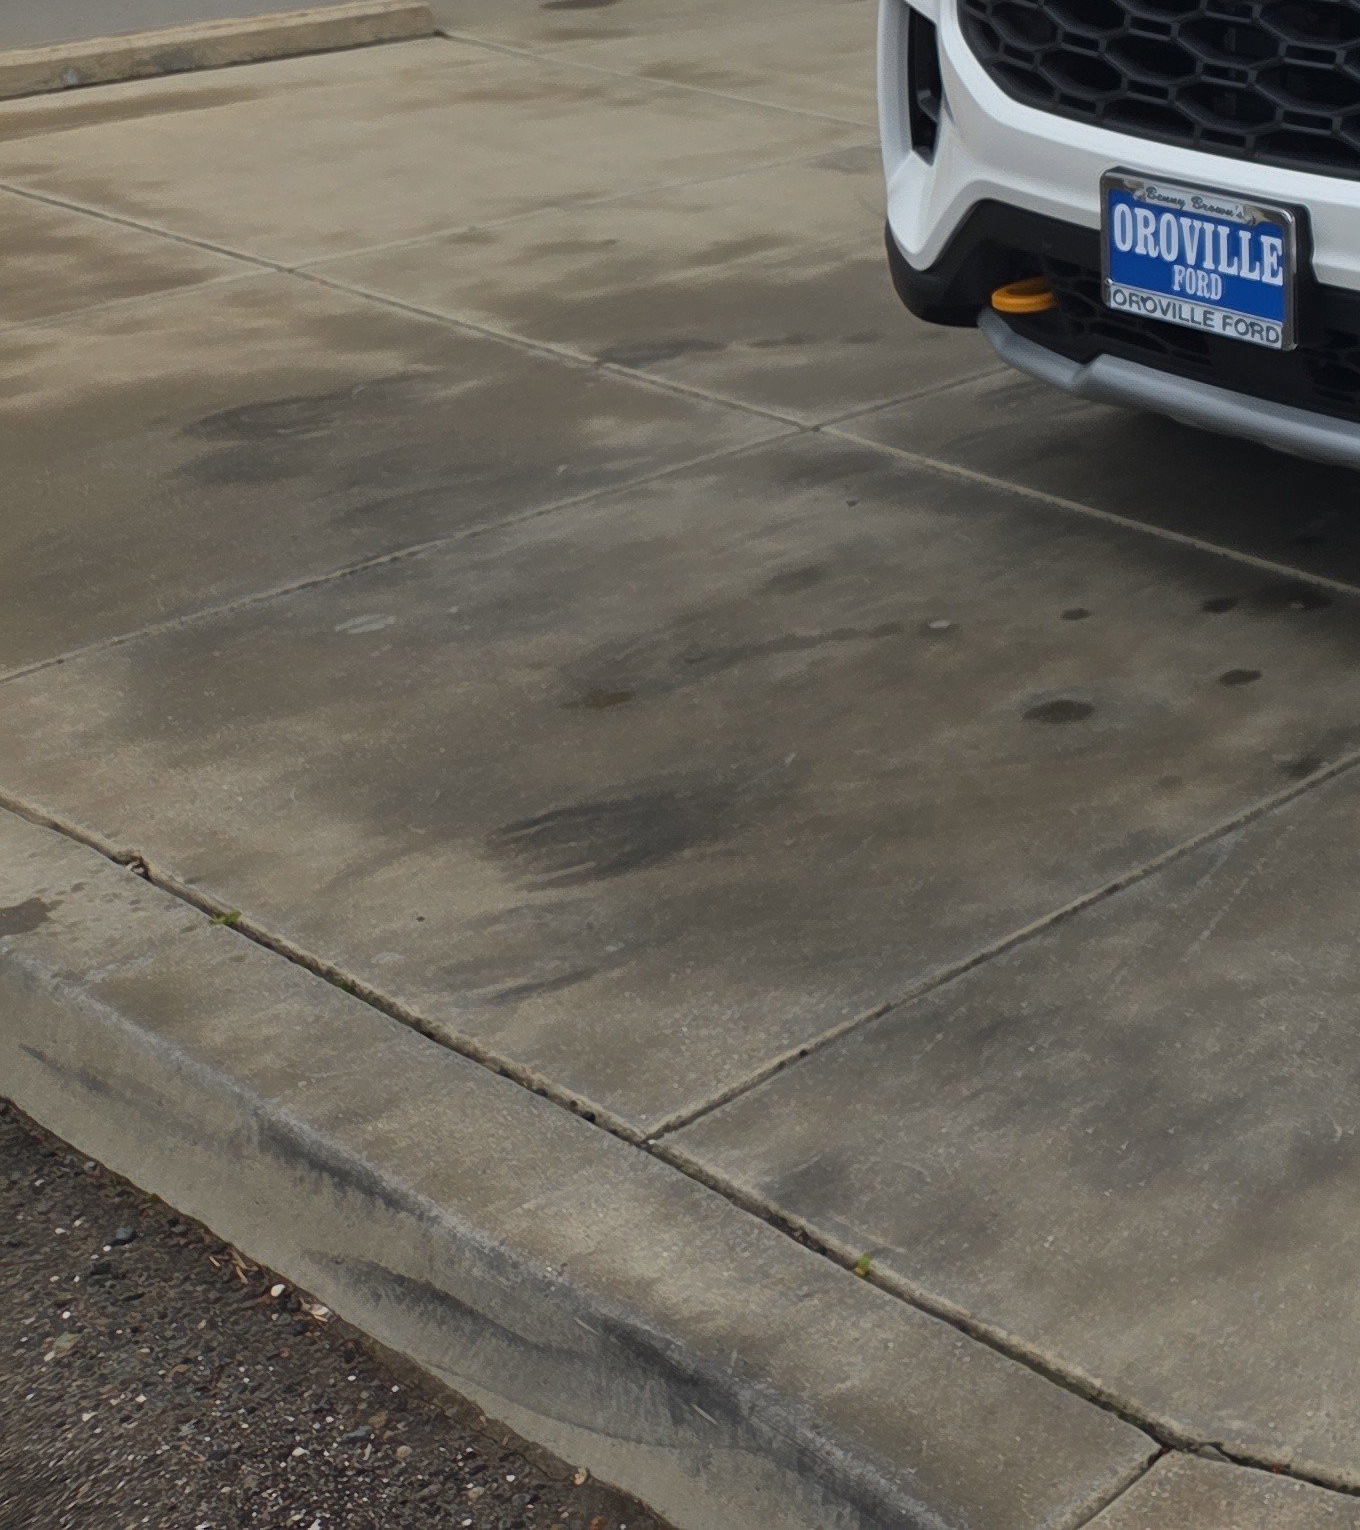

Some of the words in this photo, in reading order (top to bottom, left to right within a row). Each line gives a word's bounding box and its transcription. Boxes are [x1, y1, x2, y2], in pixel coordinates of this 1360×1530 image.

[1145, 185, 1186, 210] Benny
[1190, 195, 1245, 218] Brown's
[1113, 203, 1283, 286] OROVILLE
[1172, 264, 1223, 301] FORD
[1112, 288, 1215, 328] OROVILLE
[1221, 314, 1281, 344] FORD
